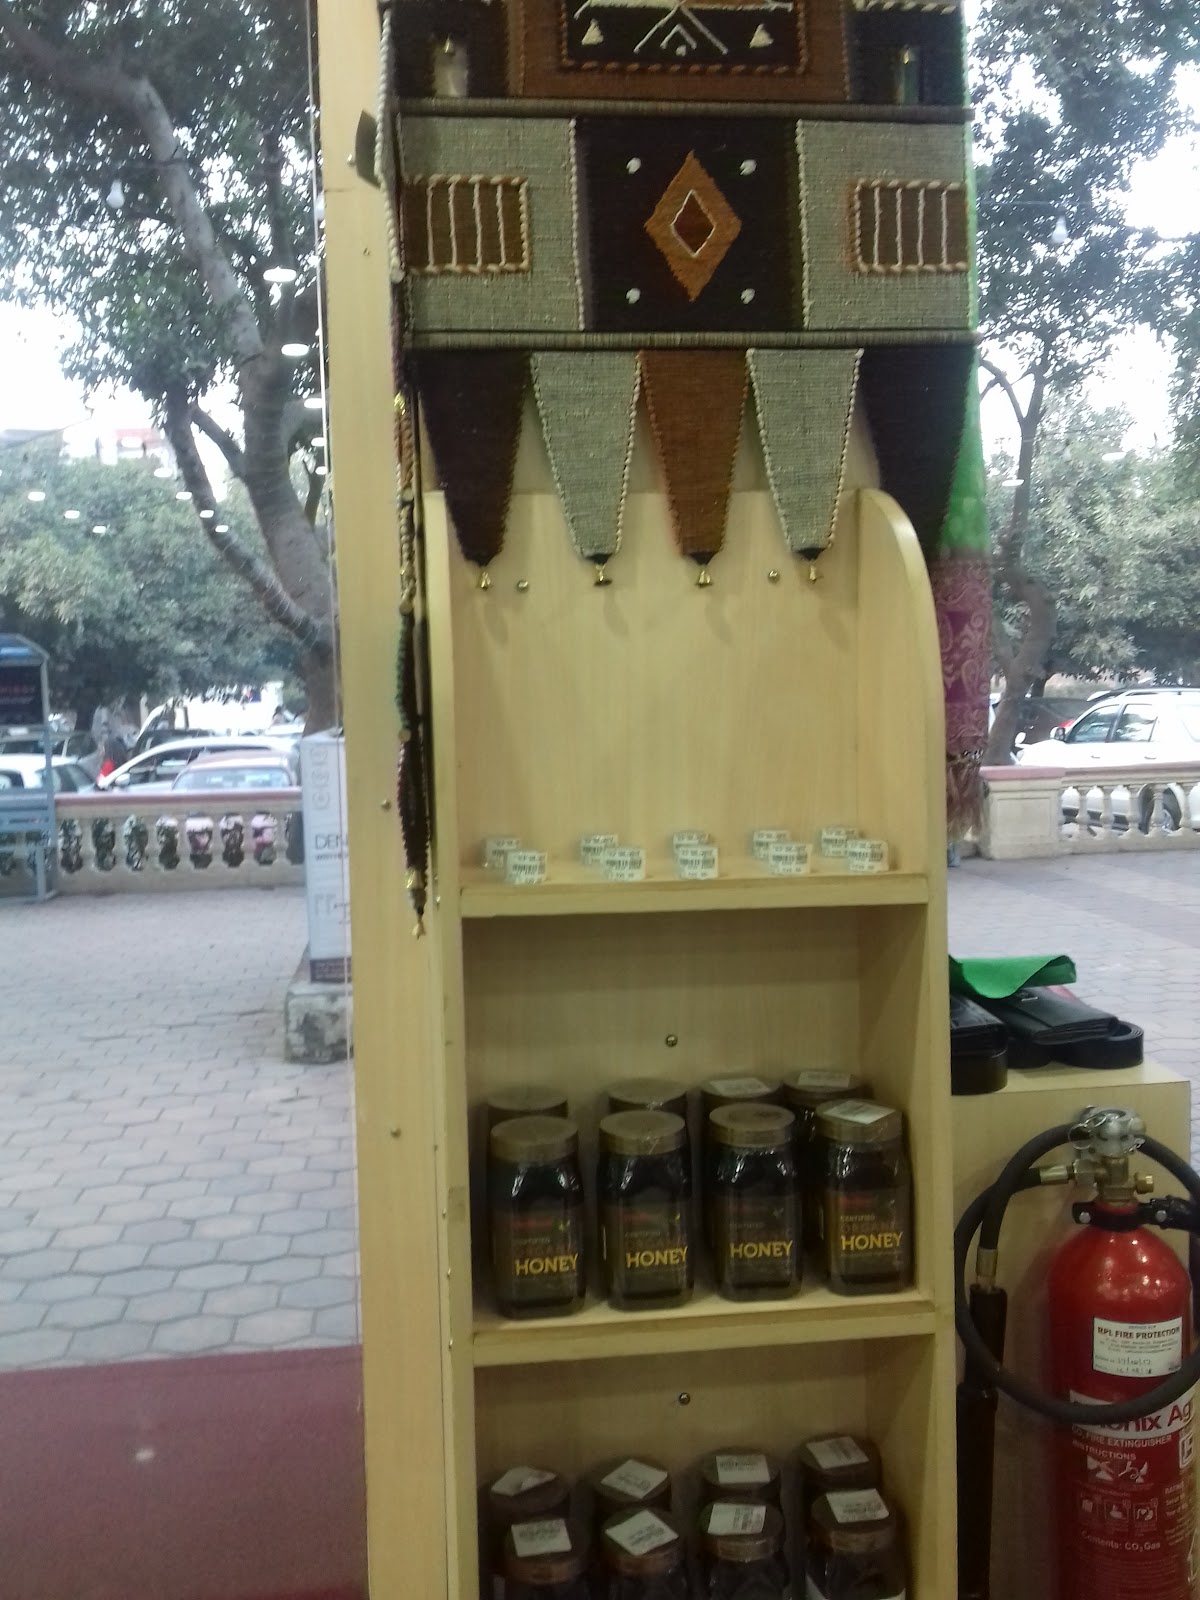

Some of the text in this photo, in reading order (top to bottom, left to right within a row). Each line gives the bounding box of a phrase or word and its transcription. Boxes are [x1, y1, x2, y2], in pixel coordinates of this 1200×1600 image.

[730, 1240, 793, 1259] HONEY
[840, 1231, 903, 1250] HONEY
[515, 1253, 578, 1275] HONEY
[625, 1246, 688, 1267] HONEY
[1115, 1330, 1134, 1340] FIRE
[1136, 1326, 1180, 1340] PROTECTION
[1072, 1440, 1136, 1460] INSTRUCTIONS
[1107, 1434, 1172, 1448] EXTINGUISHER
